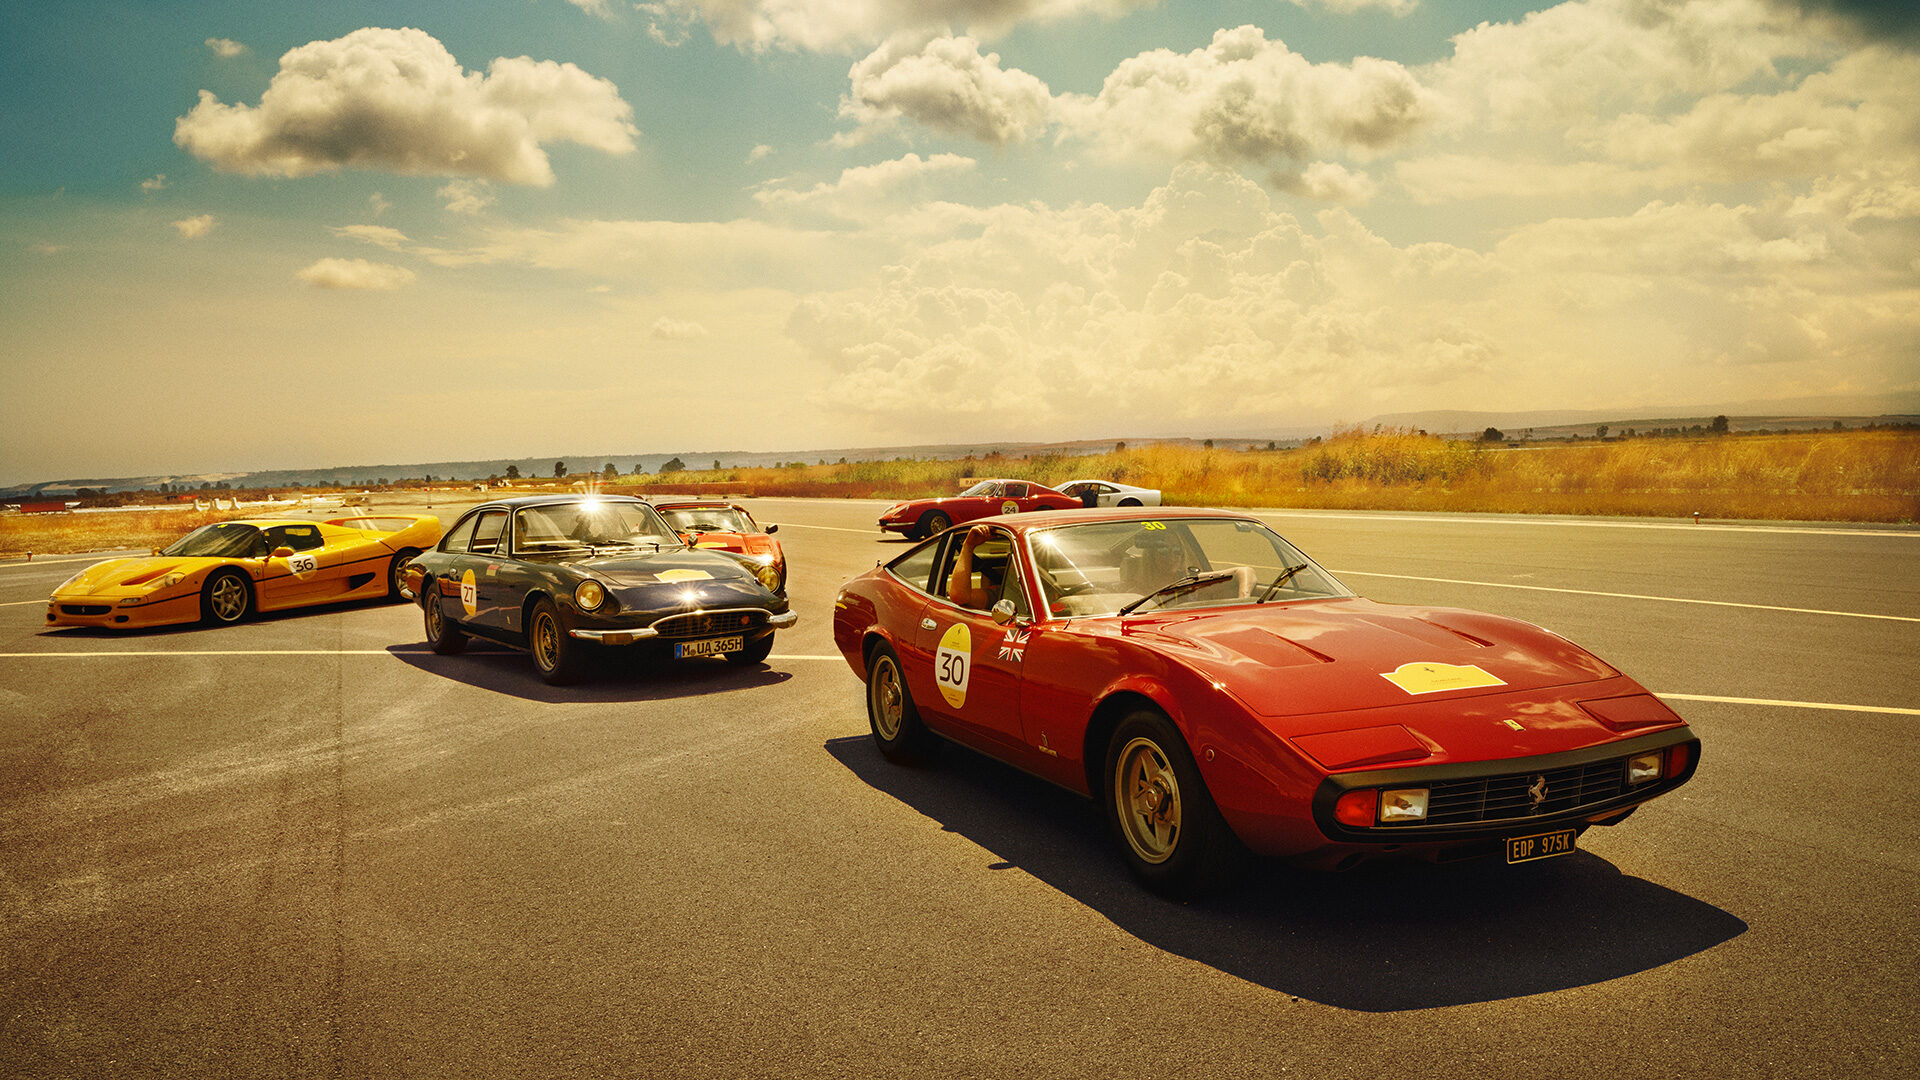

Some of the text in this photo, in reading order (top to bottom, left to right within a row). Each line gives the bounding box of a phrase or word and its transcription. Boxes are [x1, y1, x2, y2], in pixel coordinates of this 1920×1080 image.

[1004, 506, 1016, 514] 24
[1140, 521, 1167, 530] 30
[293, 558, 314, 572] 36
[463, 586, 474, 604] 27
[682, 638, 742, 657] M UA 365H
[939, 652, 964, 686] 30
[1513, 833, 1569, 858] EDP 975K
